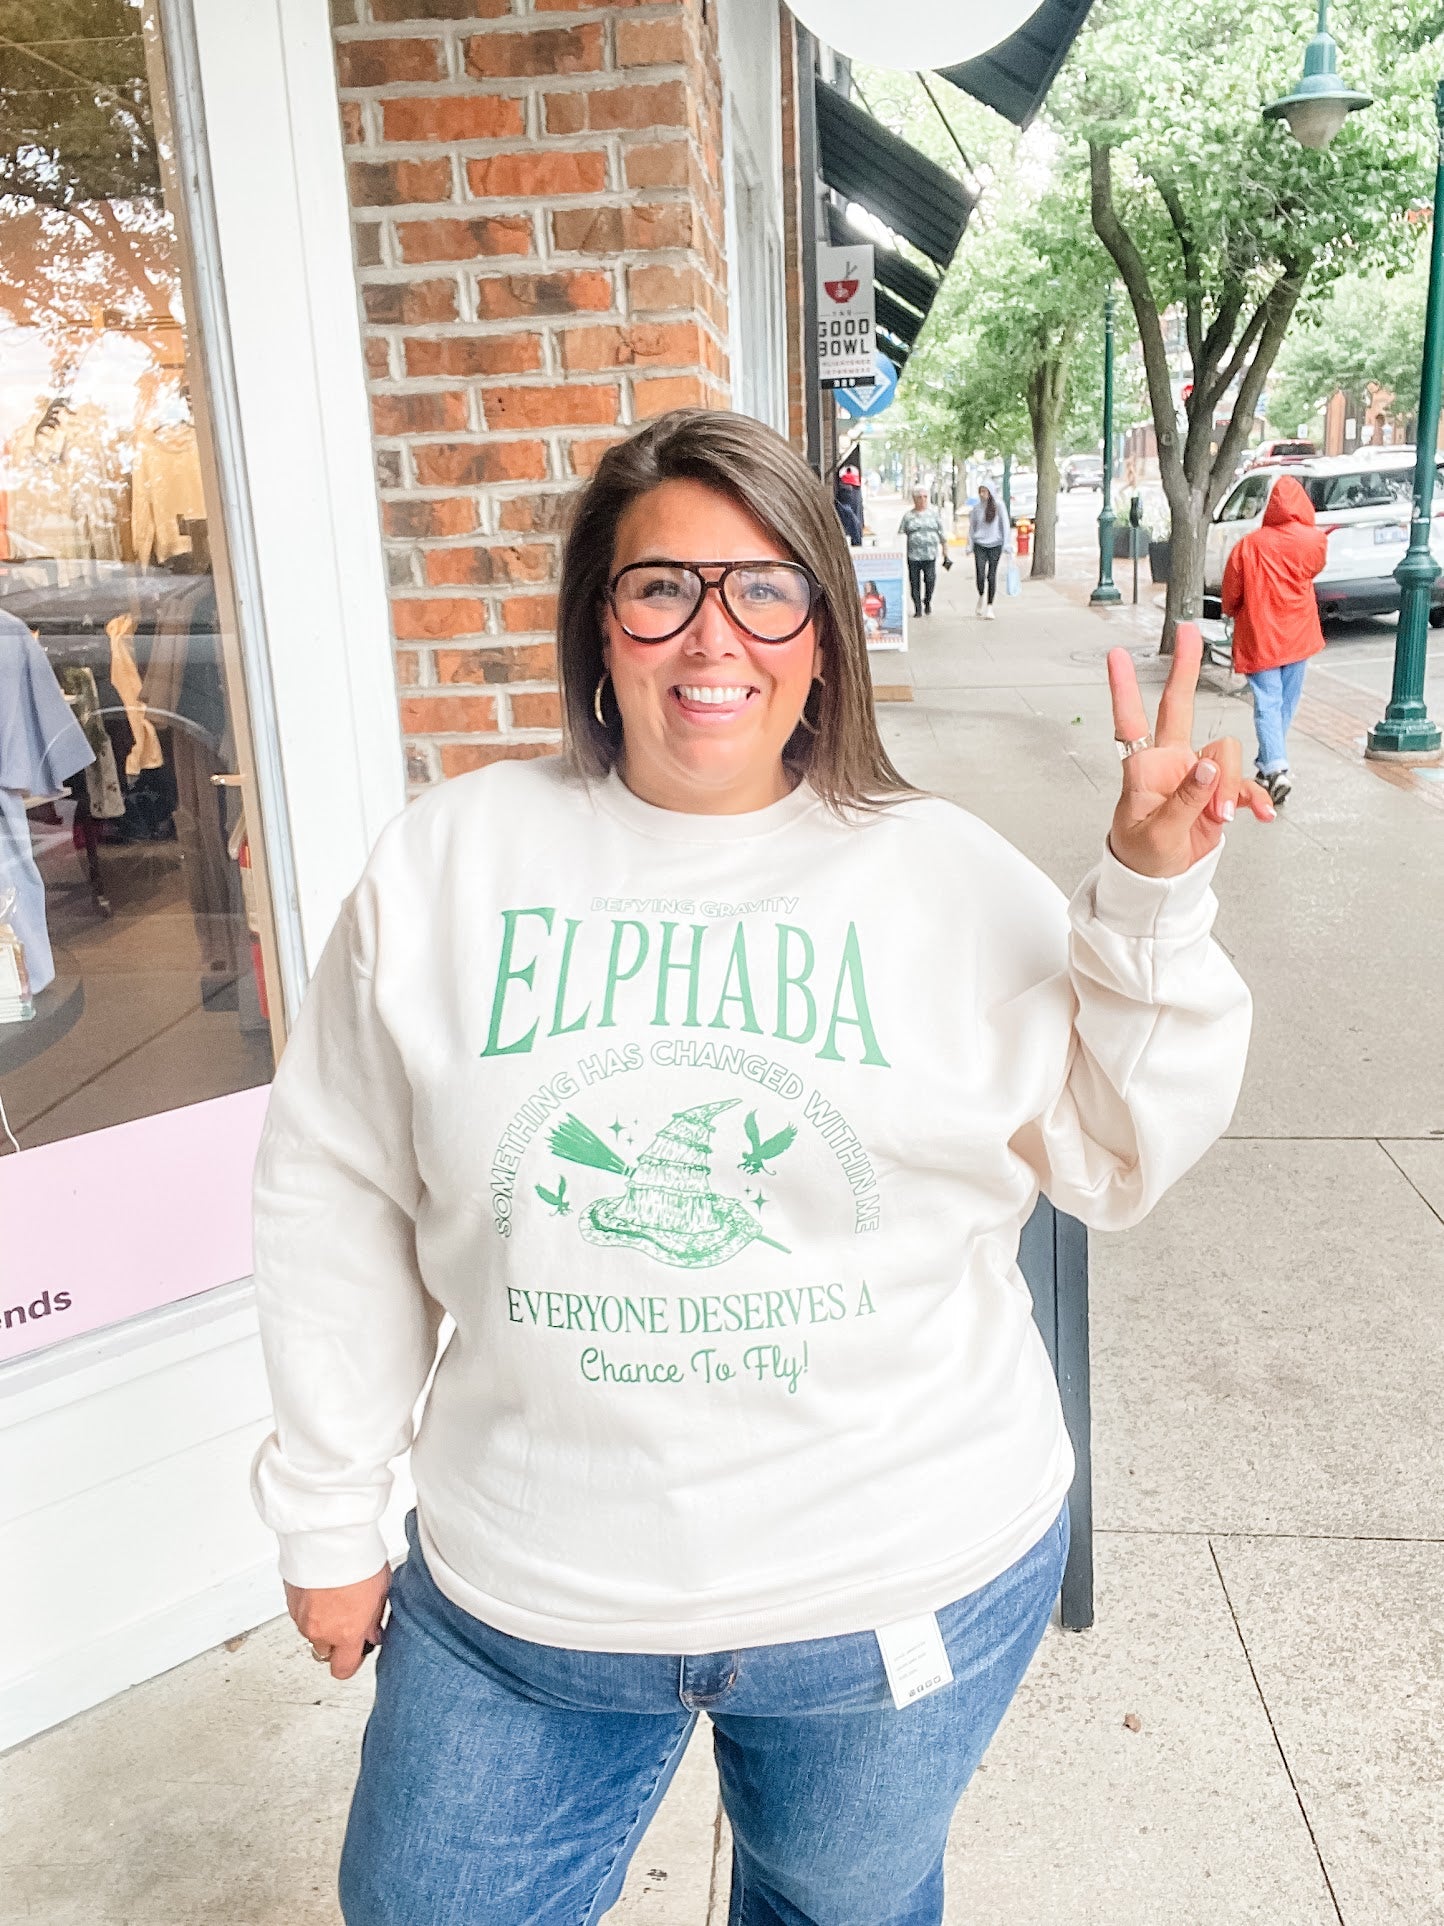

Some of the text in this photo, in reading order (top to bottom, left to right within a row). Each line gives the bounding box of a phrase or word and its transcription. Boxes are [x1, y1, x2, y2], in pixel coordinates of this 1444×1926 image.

[818, 318, 869, 337] GOOD
[819, 339, 870, 357] BOWL
[590, 896, 799, 918] DEFYING GRAVITY
[480, 907, 892, 1068] ELPHABA
[491, 1039, 881, 1238] SOMETHING HAS CHANGED WITHIN ME
[0, 1290, 72, 1329] nds
[506, 1279, 877, 1334] EVERYONE DESERVES A
[580, 1339, 810, 1394] Chance To Fly!
